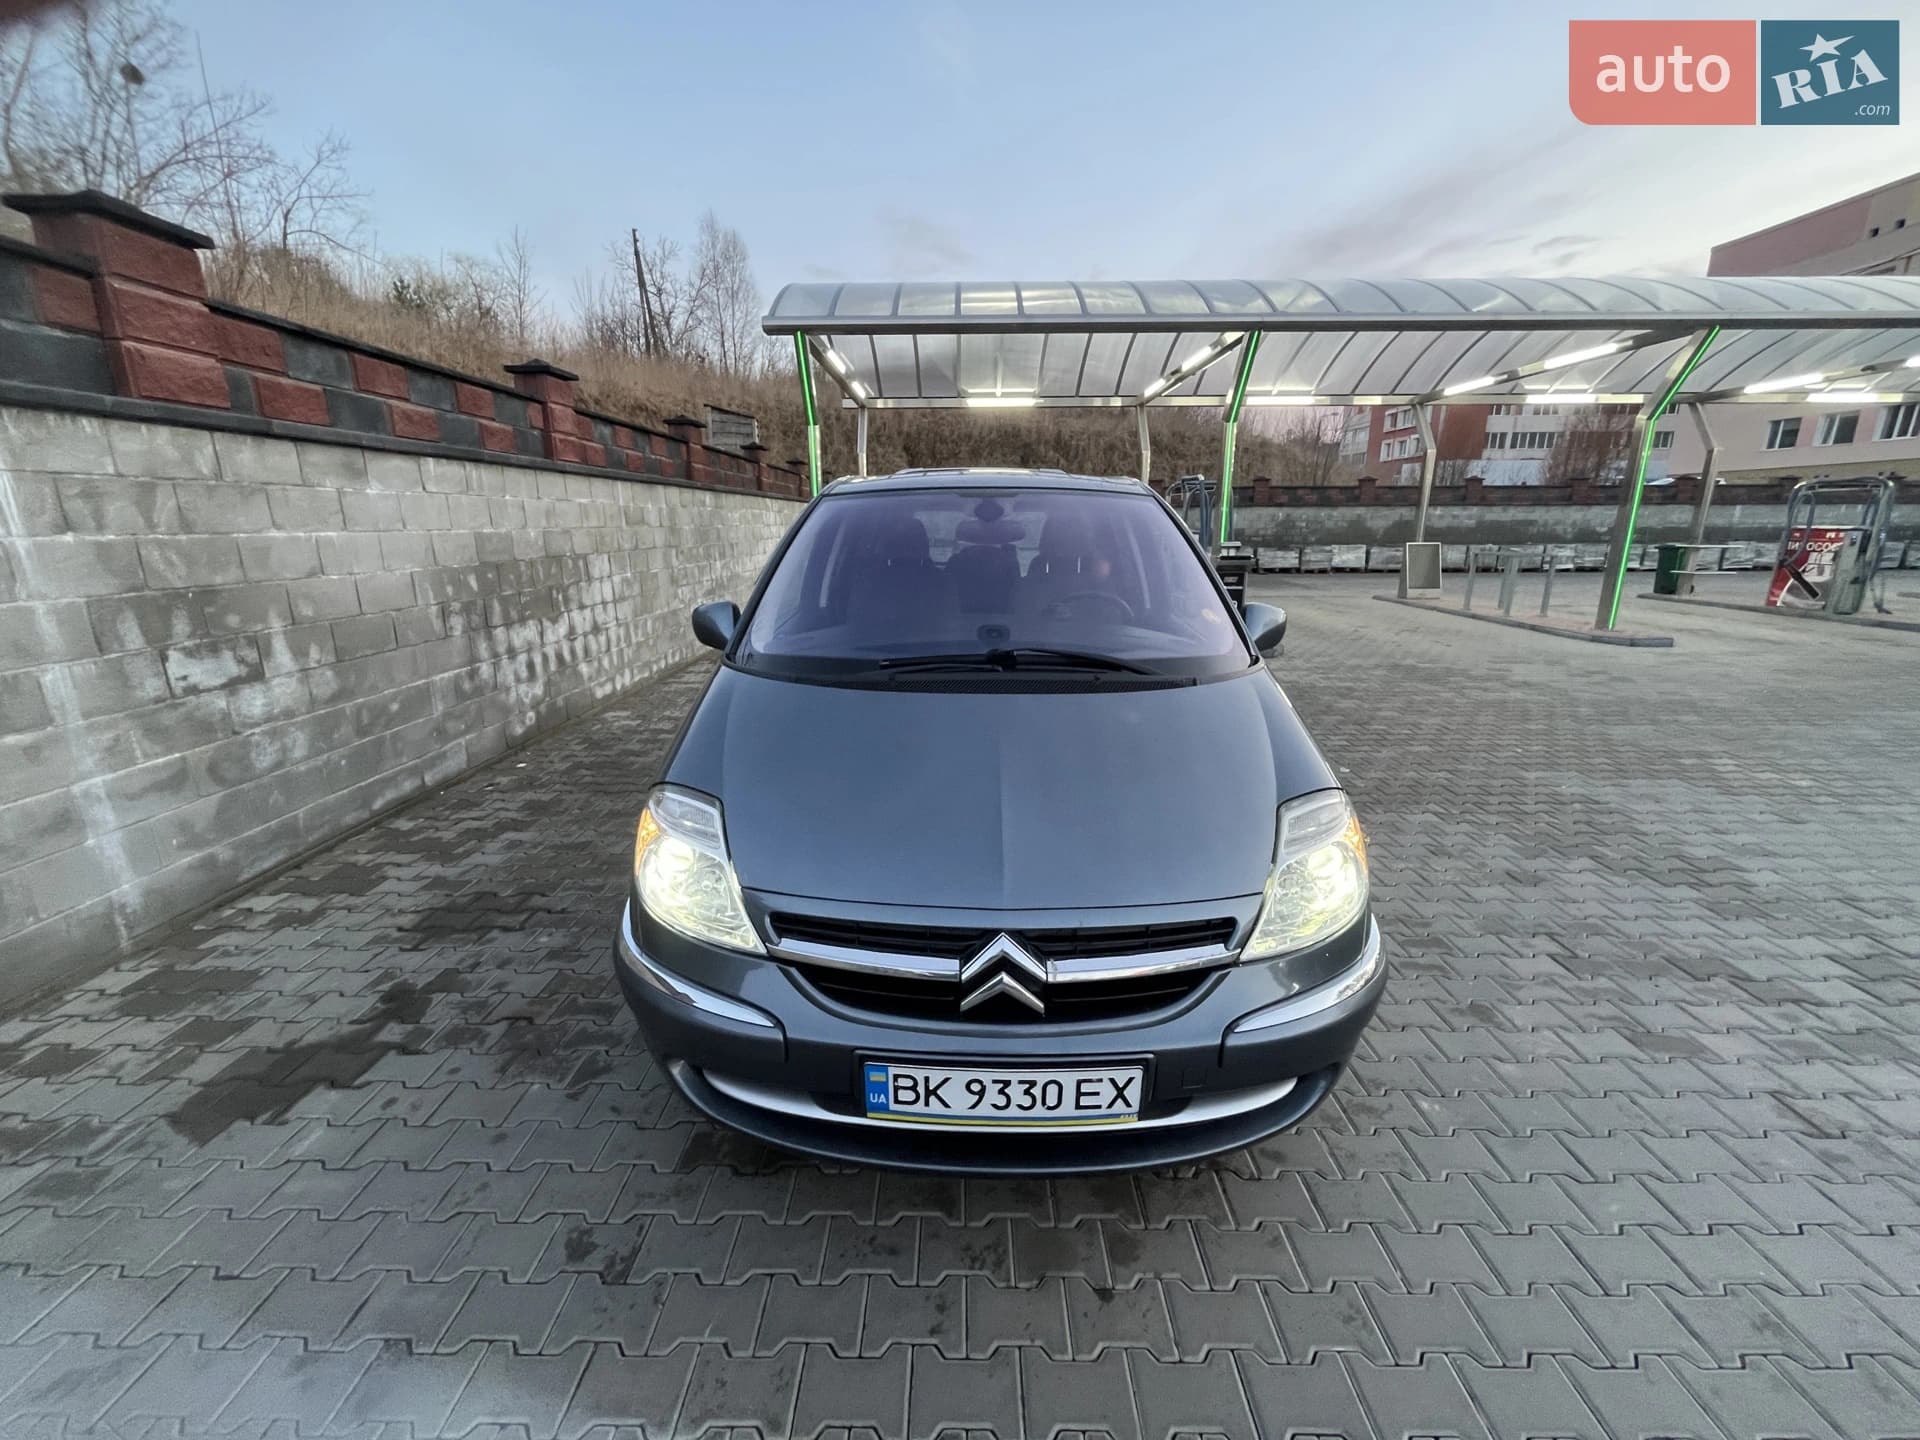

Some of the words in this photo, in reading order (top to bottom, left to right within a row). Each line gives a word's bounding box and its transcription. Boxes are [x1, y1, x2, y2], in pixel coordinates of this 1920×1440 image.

[870, 1092, 887, 1104] UA
[892, 1073, 953, 1109] BK
[965, 1078, 1063, 1111] 9330
[1074, 1076, 1136, 1110] EX
